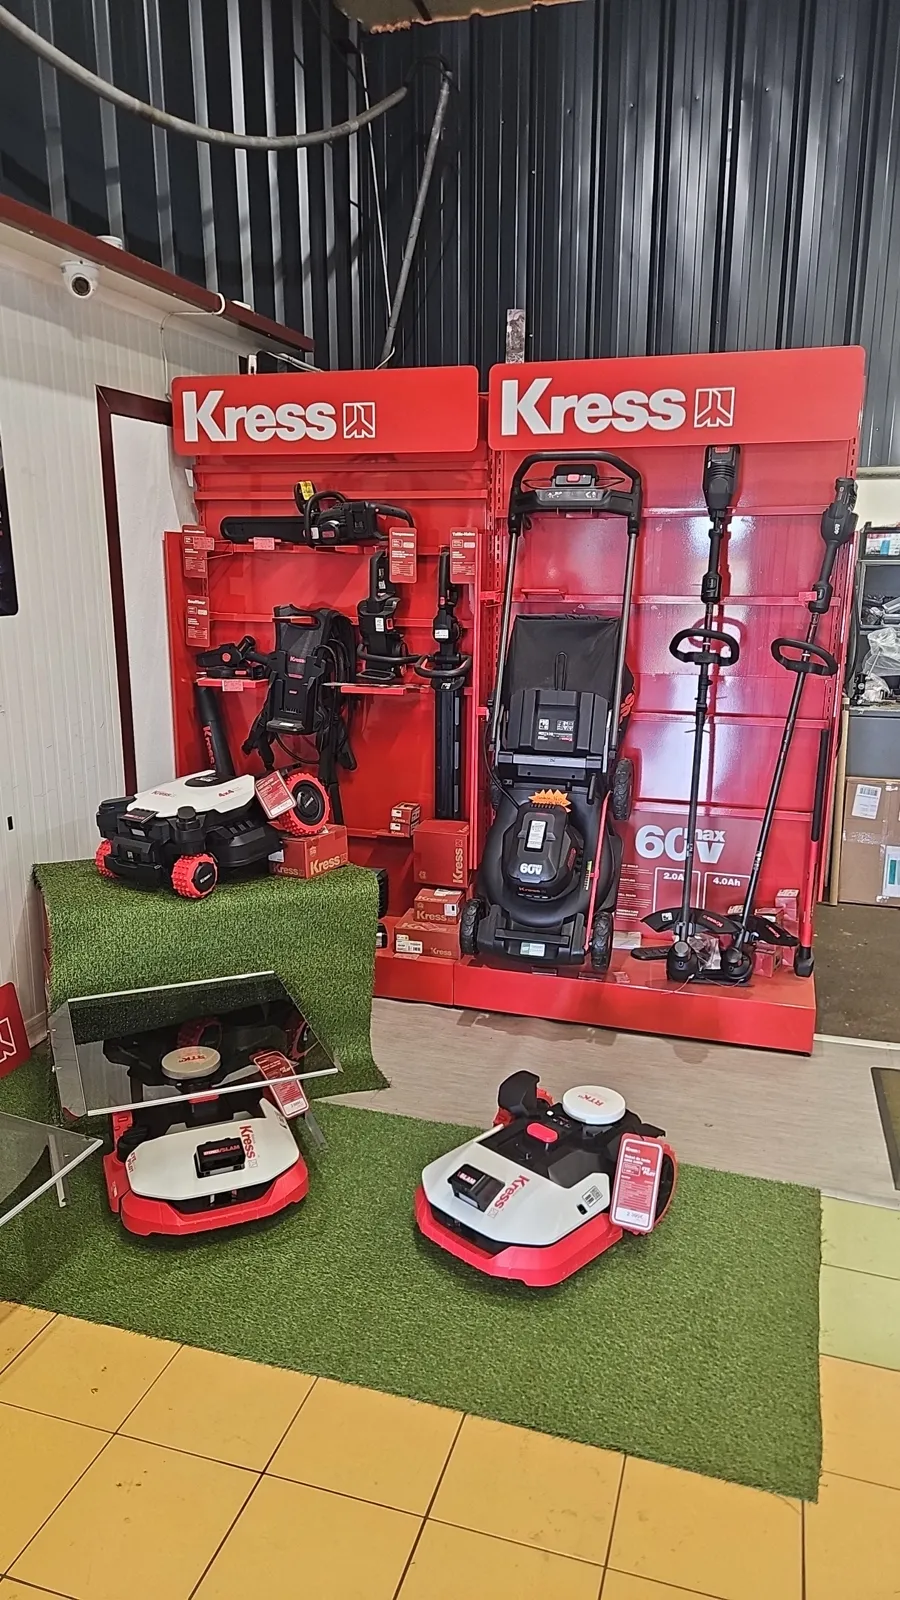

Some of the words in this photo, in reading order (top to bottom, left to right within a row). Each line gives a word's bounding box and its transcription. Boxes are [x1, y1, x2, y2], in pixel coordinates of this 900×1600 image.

[501, 377, 687, 436] Kress
[182, 390, 337, 442] Kress
[151, 790, 172, 798] Kress
[273, 863, 299, 876] Kress
[310, 855, 341, 875] Kress
[453, 847, 463, 884] Kress
[519, 863, 543, 875] 60V
[663, 872, 685, 881] 2.0A
[712, 877, 741, 887] 4.0Ah
[416, 910, 447, 922] Kress
[706, 916, 724, 928] Kress
[431, 946, 452, 957] Kress
[239, 1125, 256, 1159] Kress
[494, 1174, 530, 1209] Kress
